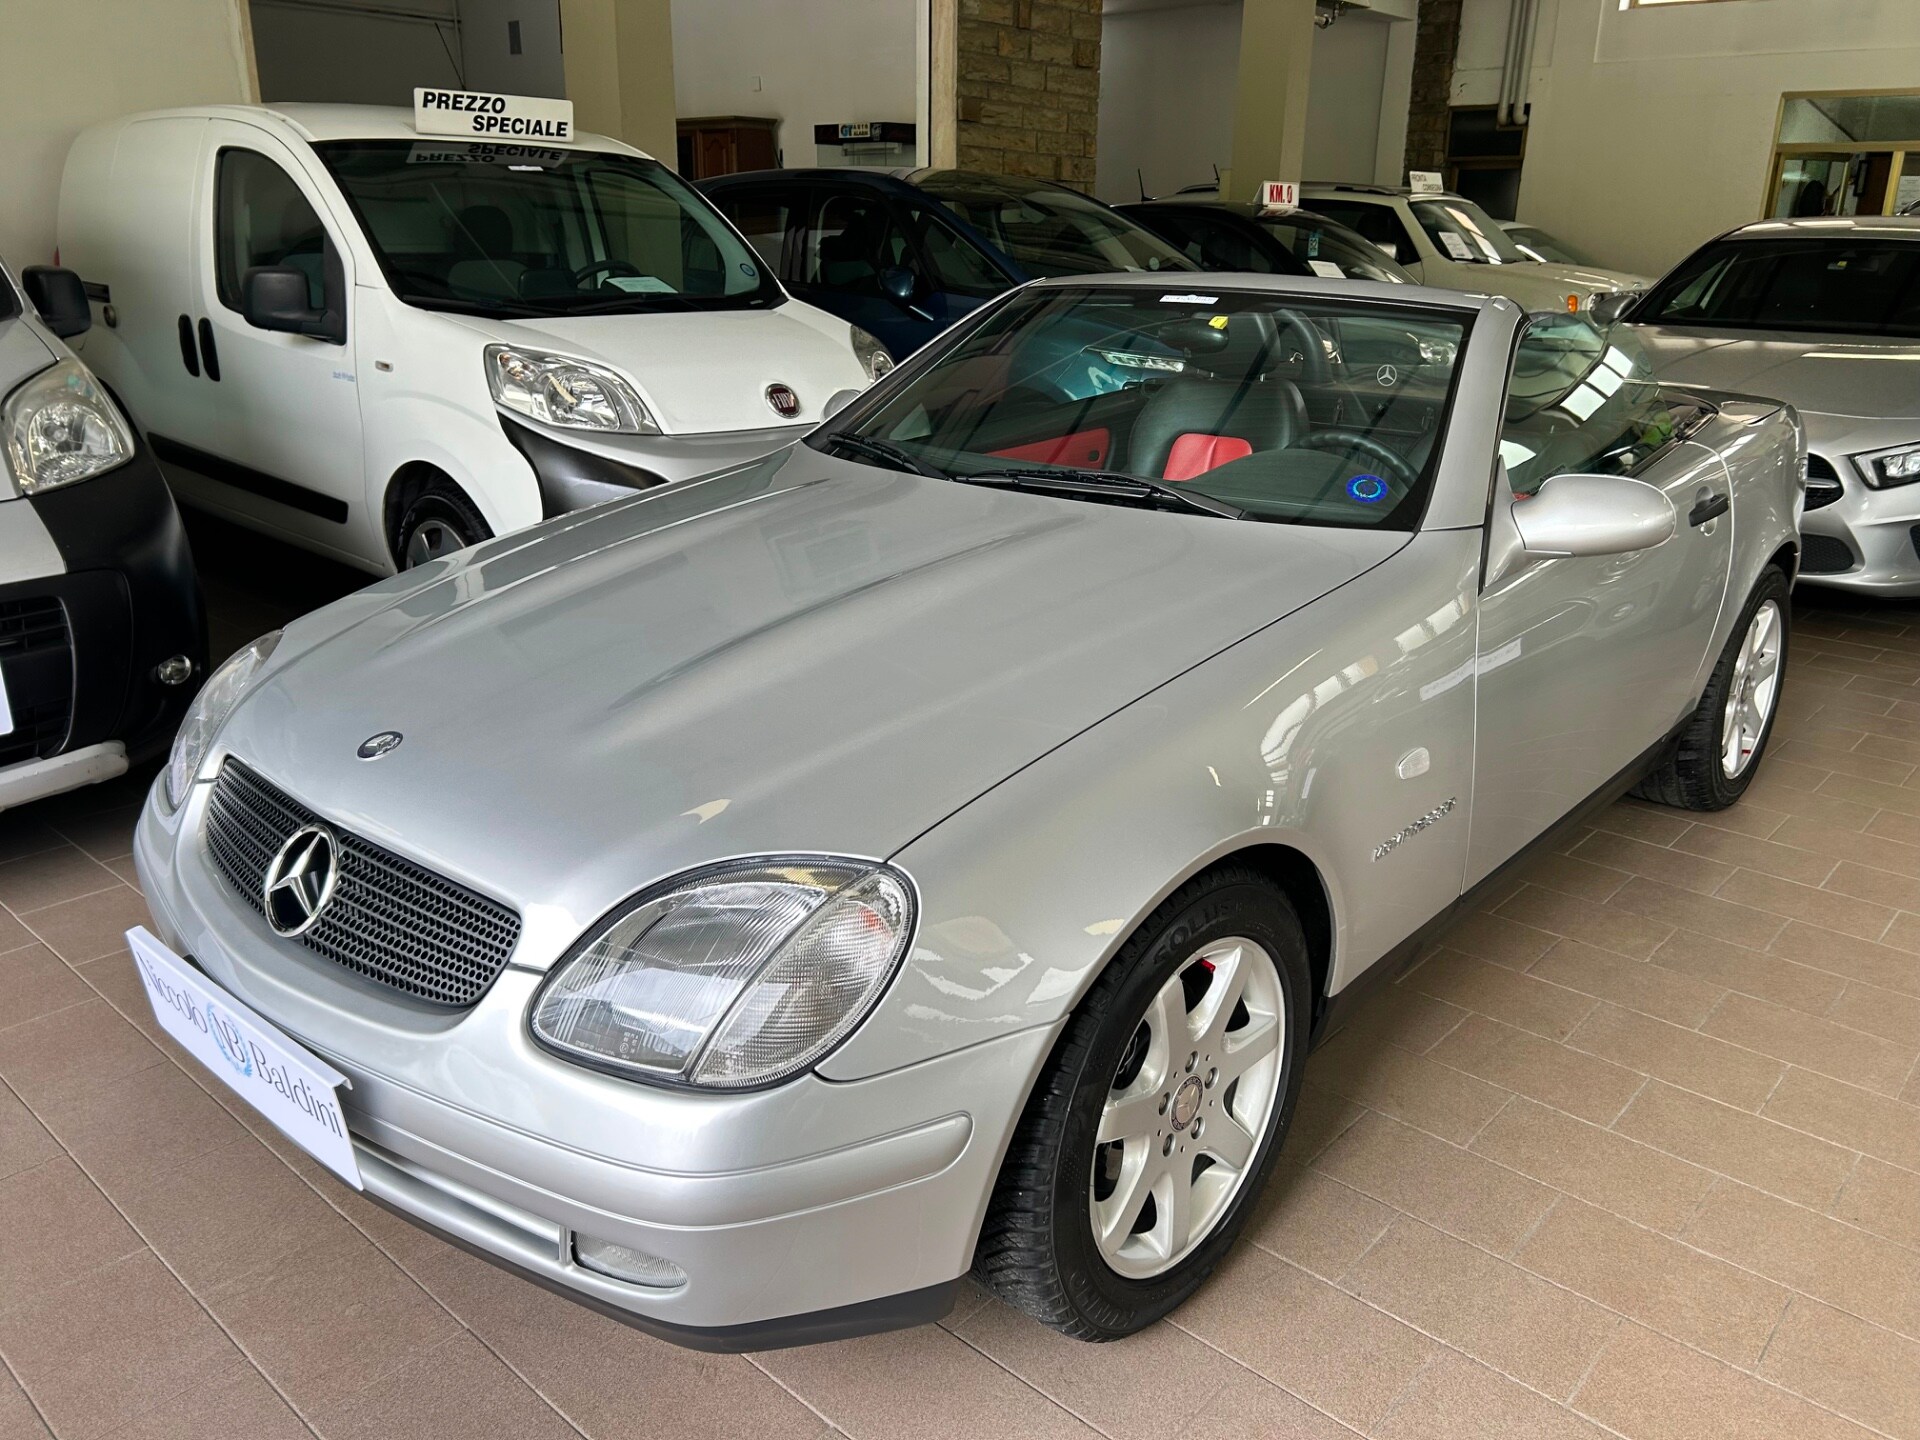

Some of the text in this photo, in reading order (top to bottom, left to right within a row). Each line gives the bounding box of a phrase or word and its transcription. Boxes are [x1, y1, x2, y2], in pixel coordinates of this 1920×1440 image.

[422, 91, 506, 114] PREZZO
[472, 115, 568, 137] SPECIALE
[1269, 184, 1285, 204] KM.
[248, 1039, 343, 1139] Baldini
